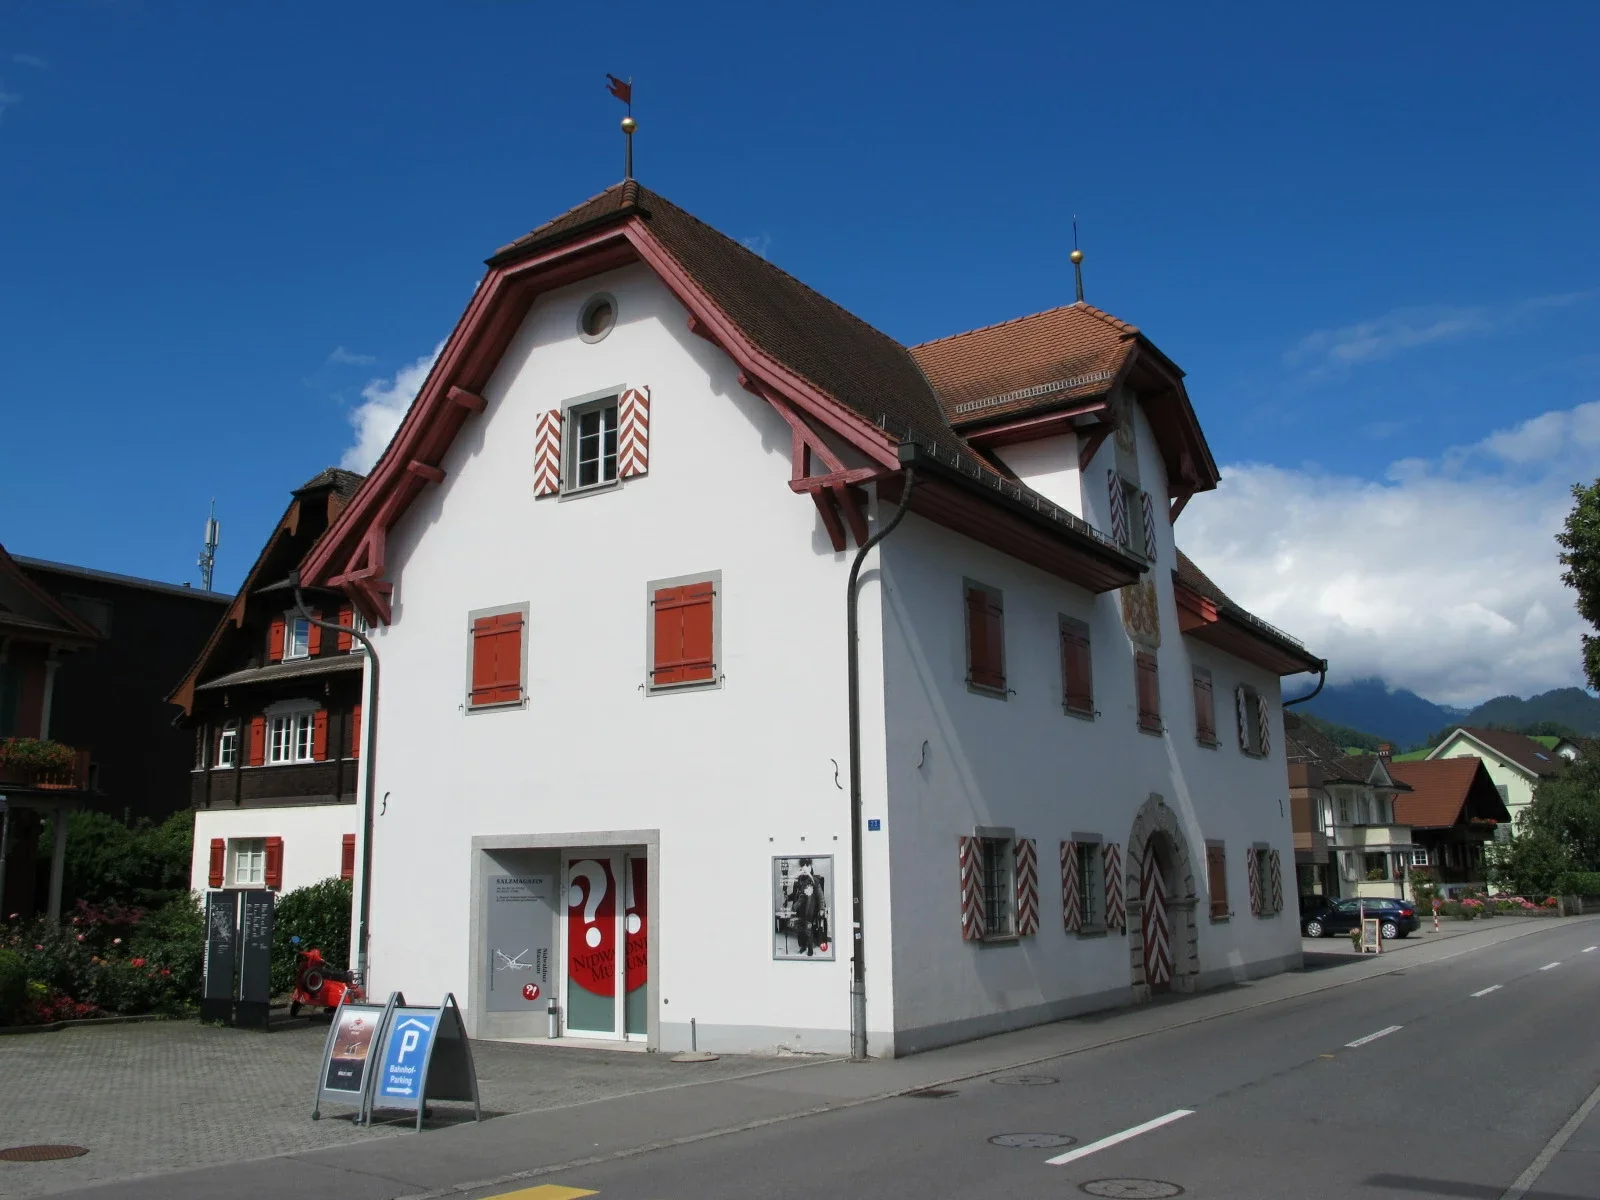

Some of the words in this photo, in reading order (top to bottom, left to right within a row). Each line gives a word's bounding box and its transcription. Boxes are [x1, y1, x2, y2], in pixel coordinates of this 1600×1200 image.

[398, 1030, 420, 1064] P
[389, 1064, 416, 1074] Bahnhof-
[390, 1075, 412, 1087] Parking
